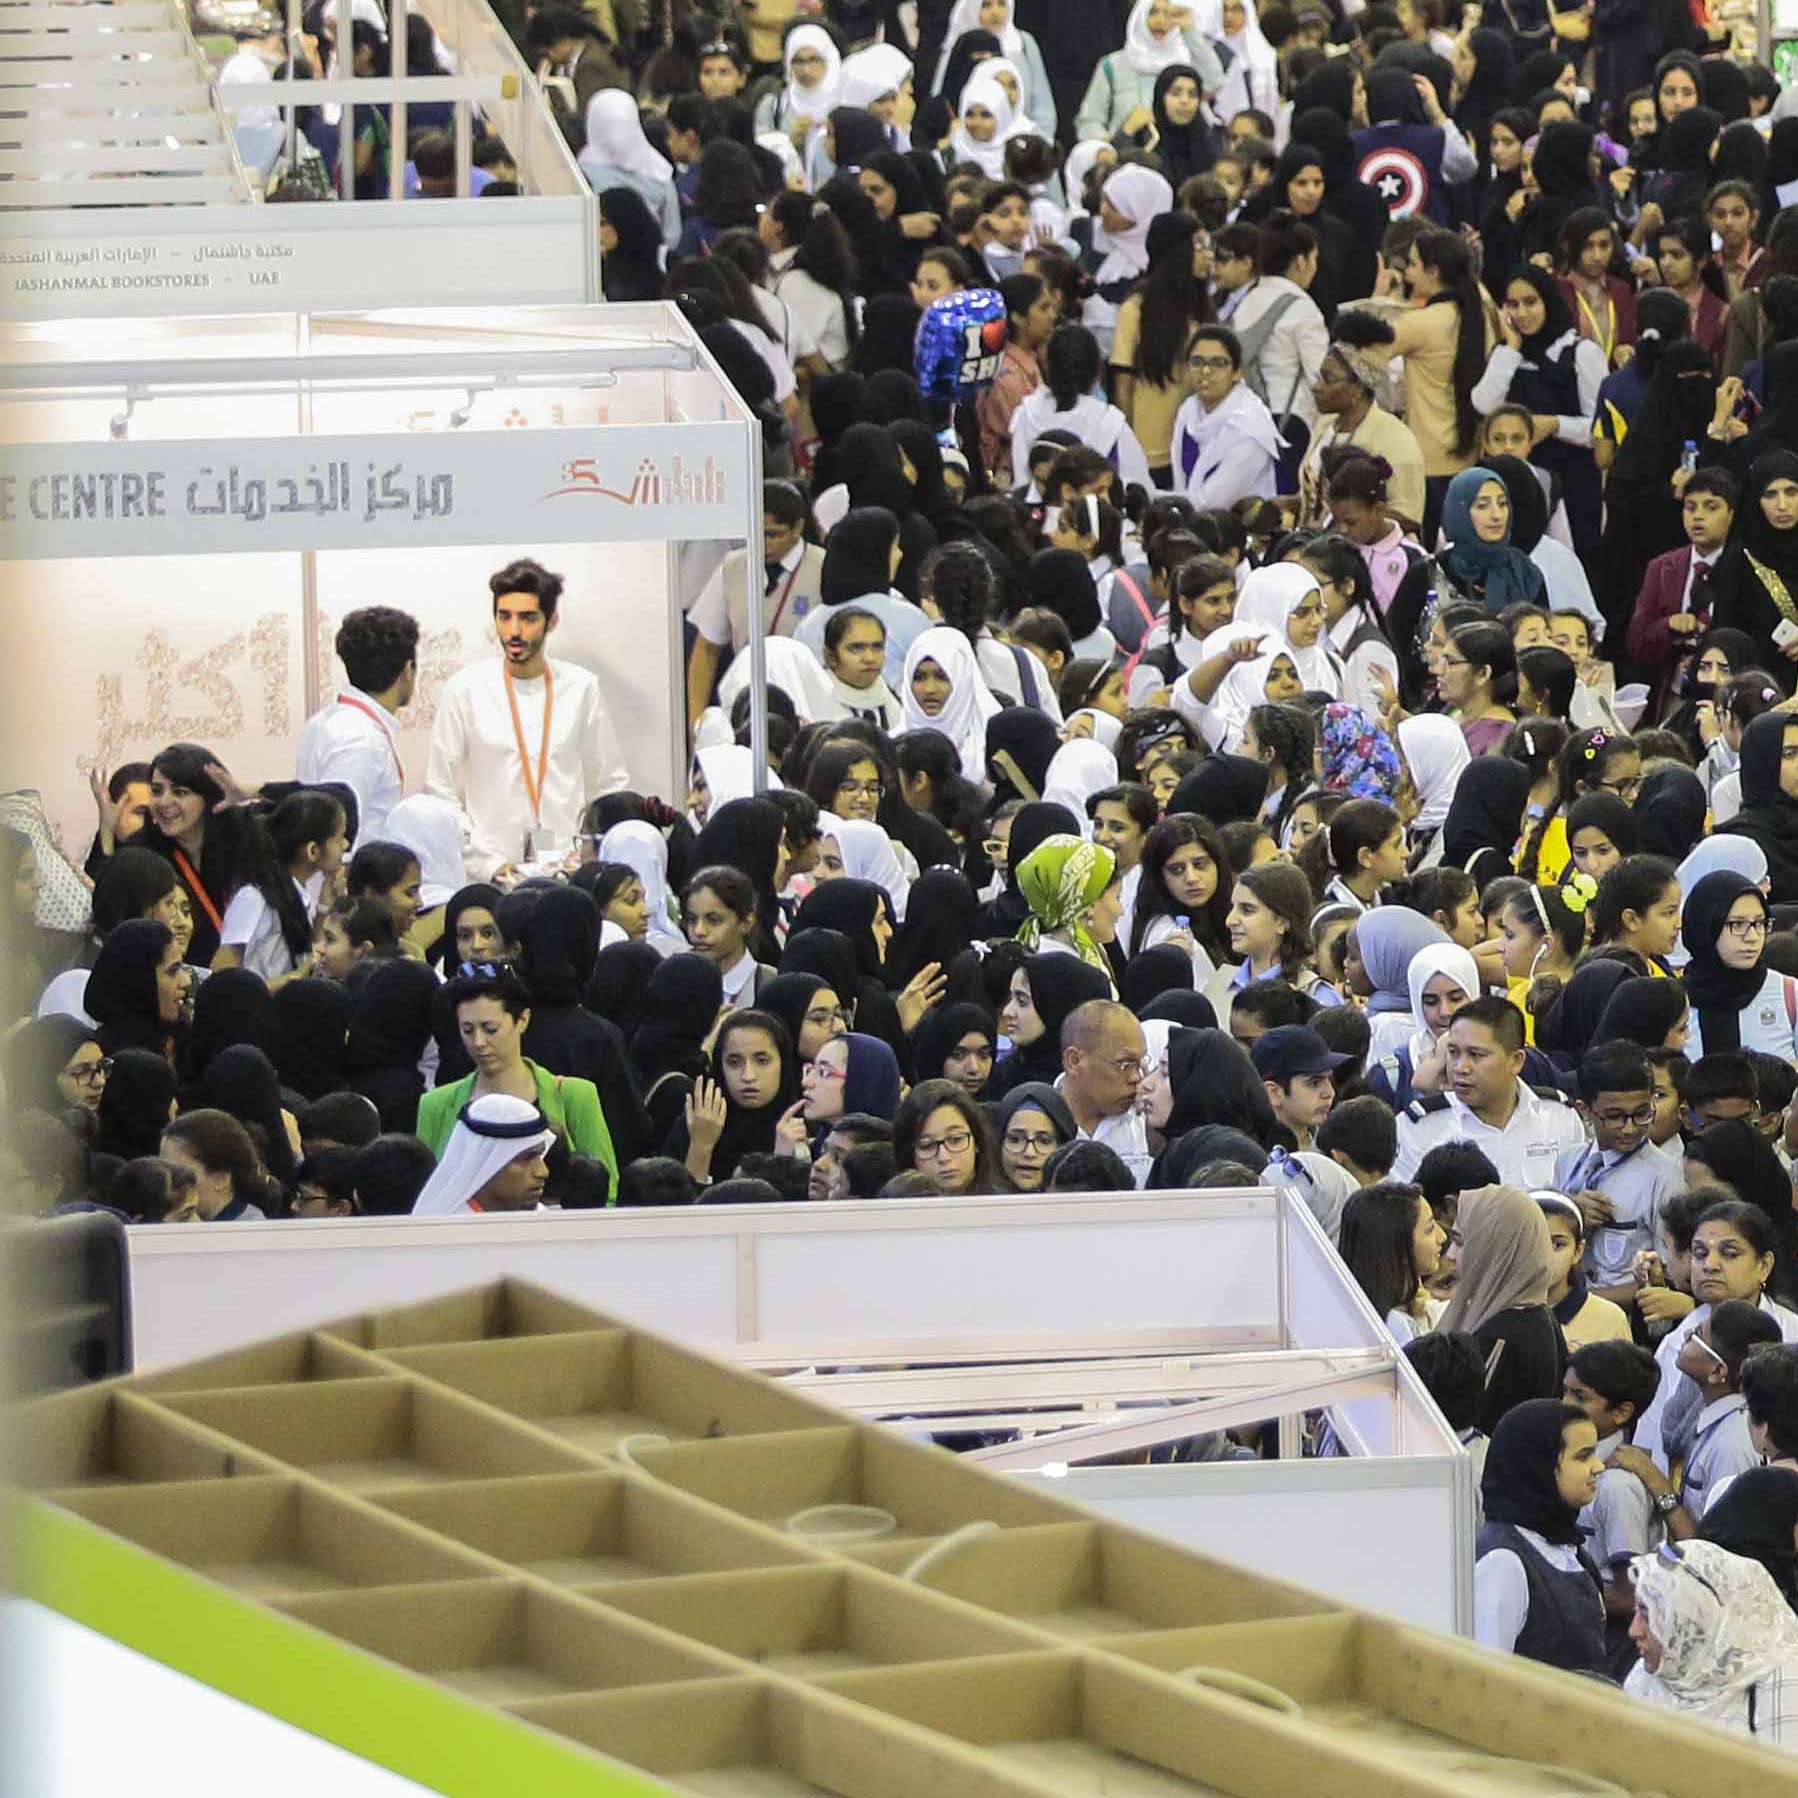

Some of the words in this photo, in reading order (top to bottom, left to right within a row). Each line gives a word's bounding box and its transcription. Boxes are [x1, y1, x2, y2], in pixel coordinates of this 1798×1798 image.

[14, 275, 109, 291] JASHANMAL
[111, 272, 211, 289] BOOKSTORES
[249, 271, 281, 286] UAE
[28, 471, 166, 521] CENTRE
[186, 462, 351, 521] الخدمات
[363, 463, 454, 521] مركز
